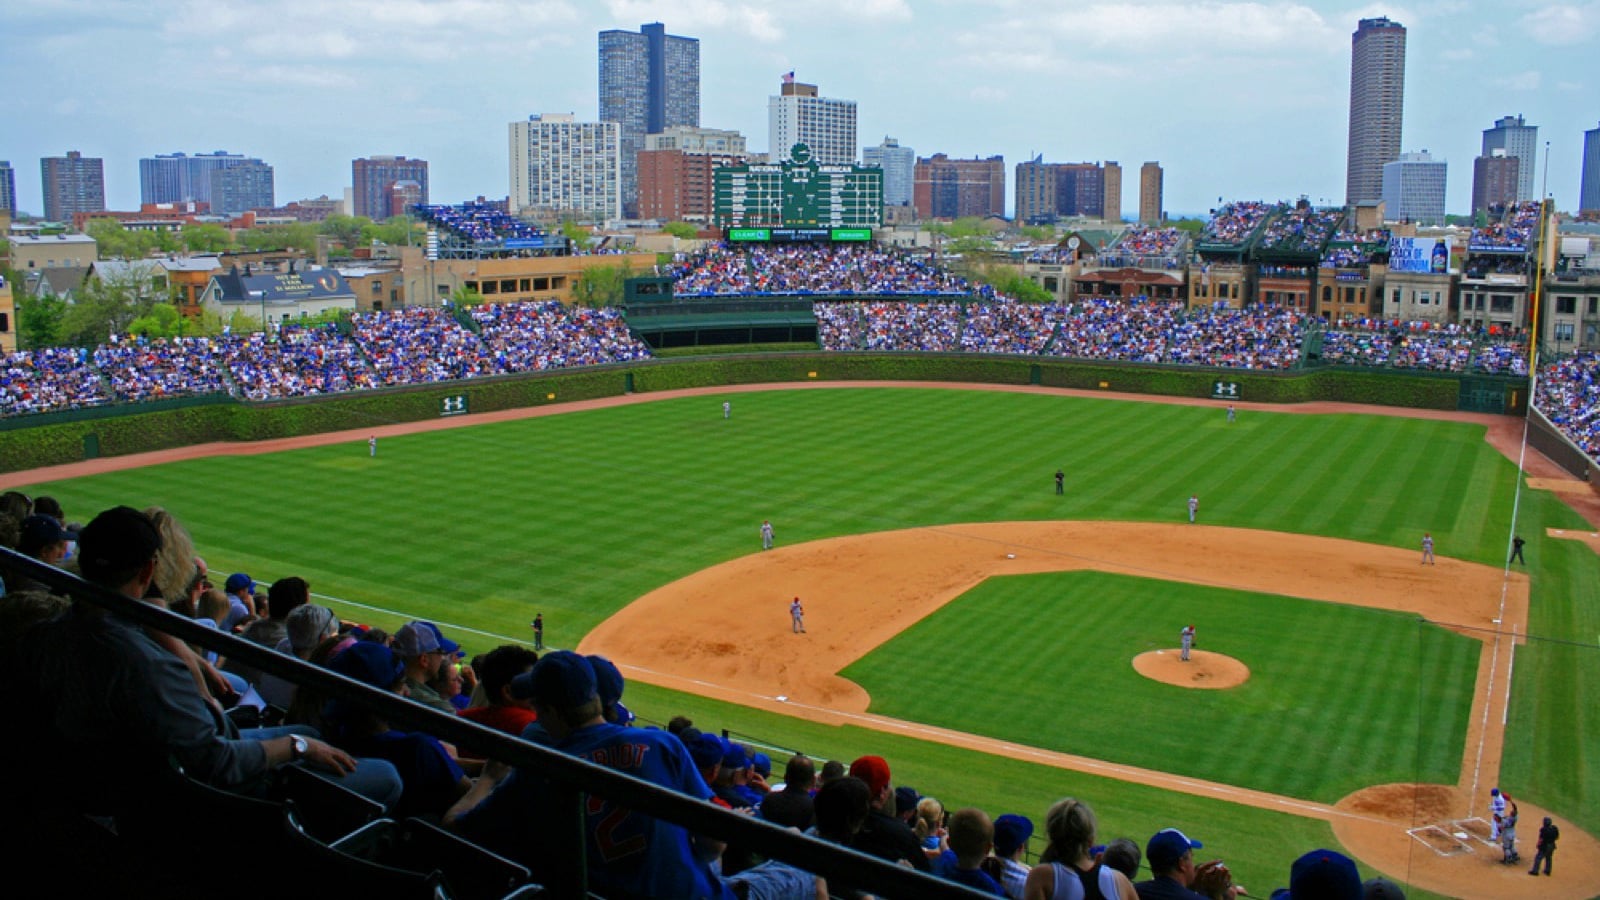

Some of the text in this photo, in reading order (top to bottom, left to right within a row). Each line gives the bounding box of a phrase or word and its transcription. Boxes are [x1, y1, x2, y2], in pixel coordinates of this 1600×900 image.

[1402, 238, 1414, 248] THE
[1390, 248, 1424, 259] CRACK OF
[1390, 259, 1428, 271] ALUMINUM
